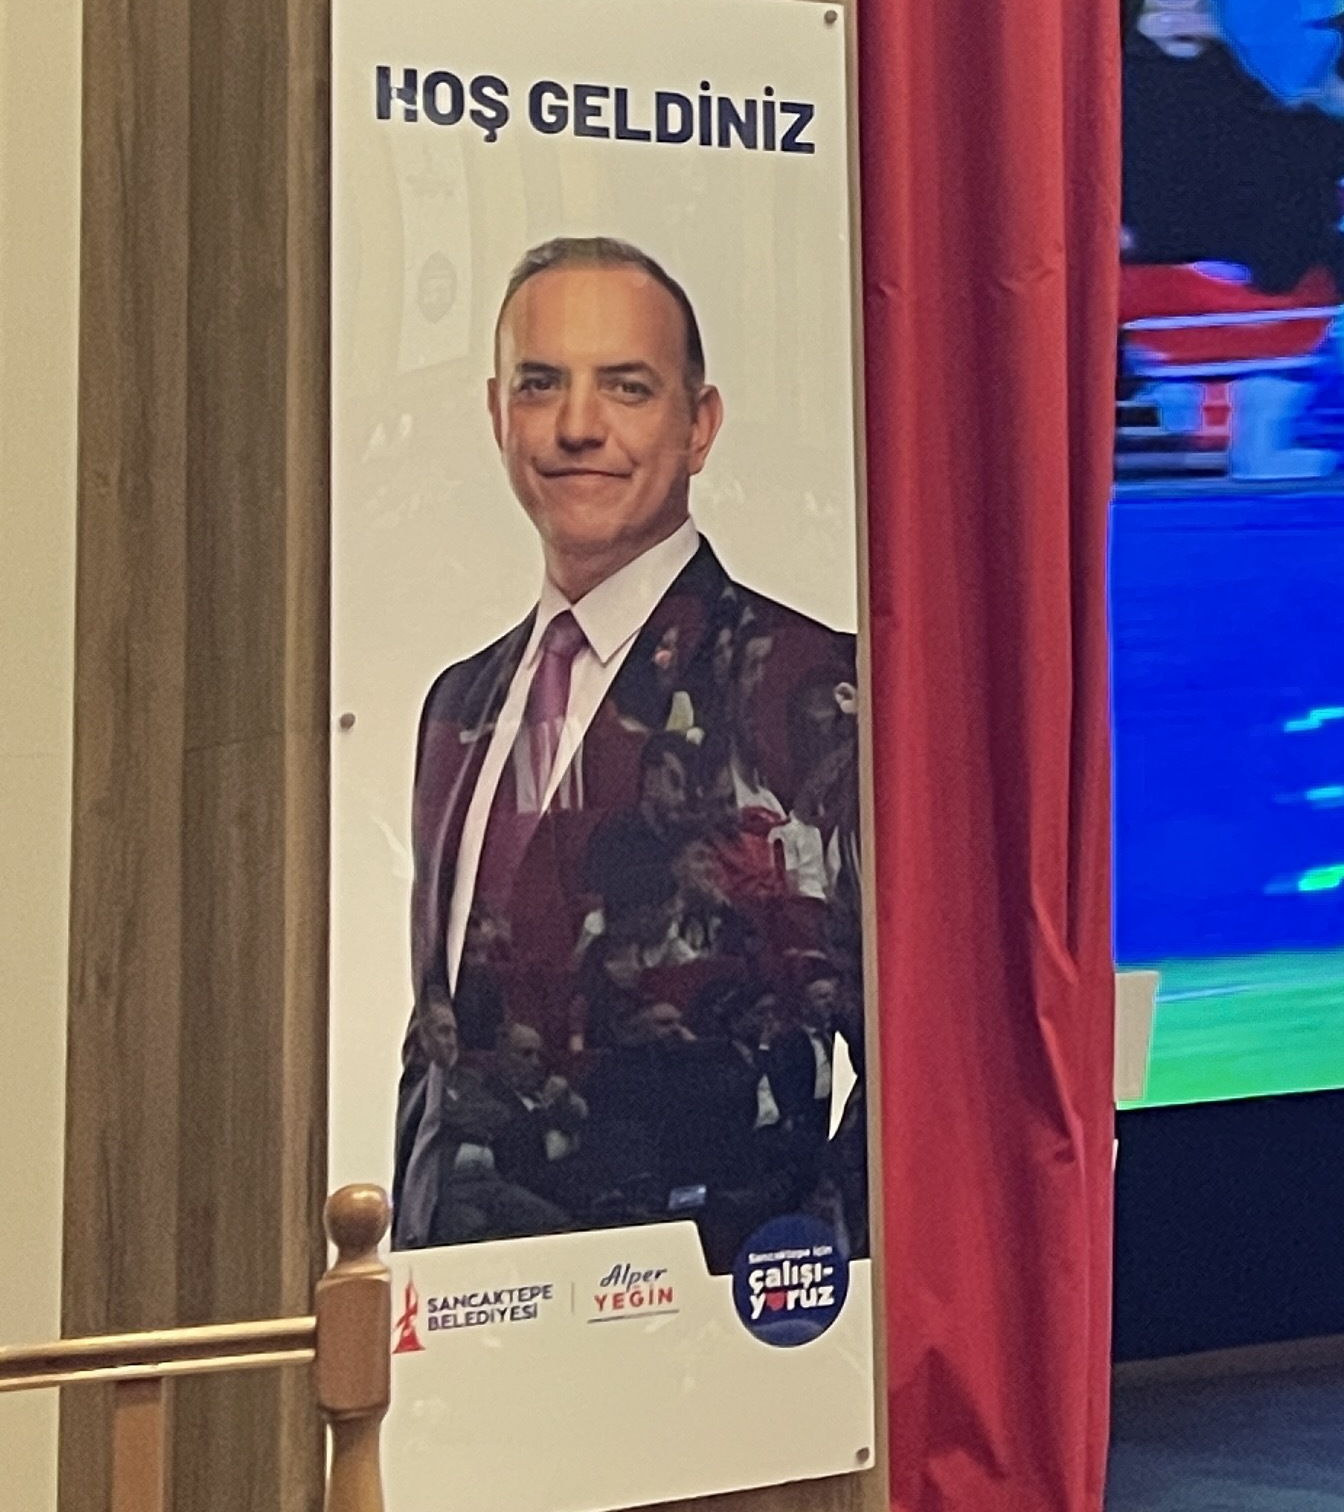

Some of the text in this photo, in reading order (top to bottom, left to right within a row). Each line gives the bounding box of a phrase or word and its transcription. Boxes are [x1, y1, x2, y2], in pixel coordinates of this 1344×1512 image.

[375, 64, 817, 155] HOŞ GELDİNİZ
[600, 1263, 667, 1292] Alper
[427, 1284, 553, 1314] SANCAKTEPE
[594, 1285, 674, 1312] YEĞİN
[749, 1285, 835, 1320] yruz
[428, 1303, 538, 1331] BELEDİYESİ
